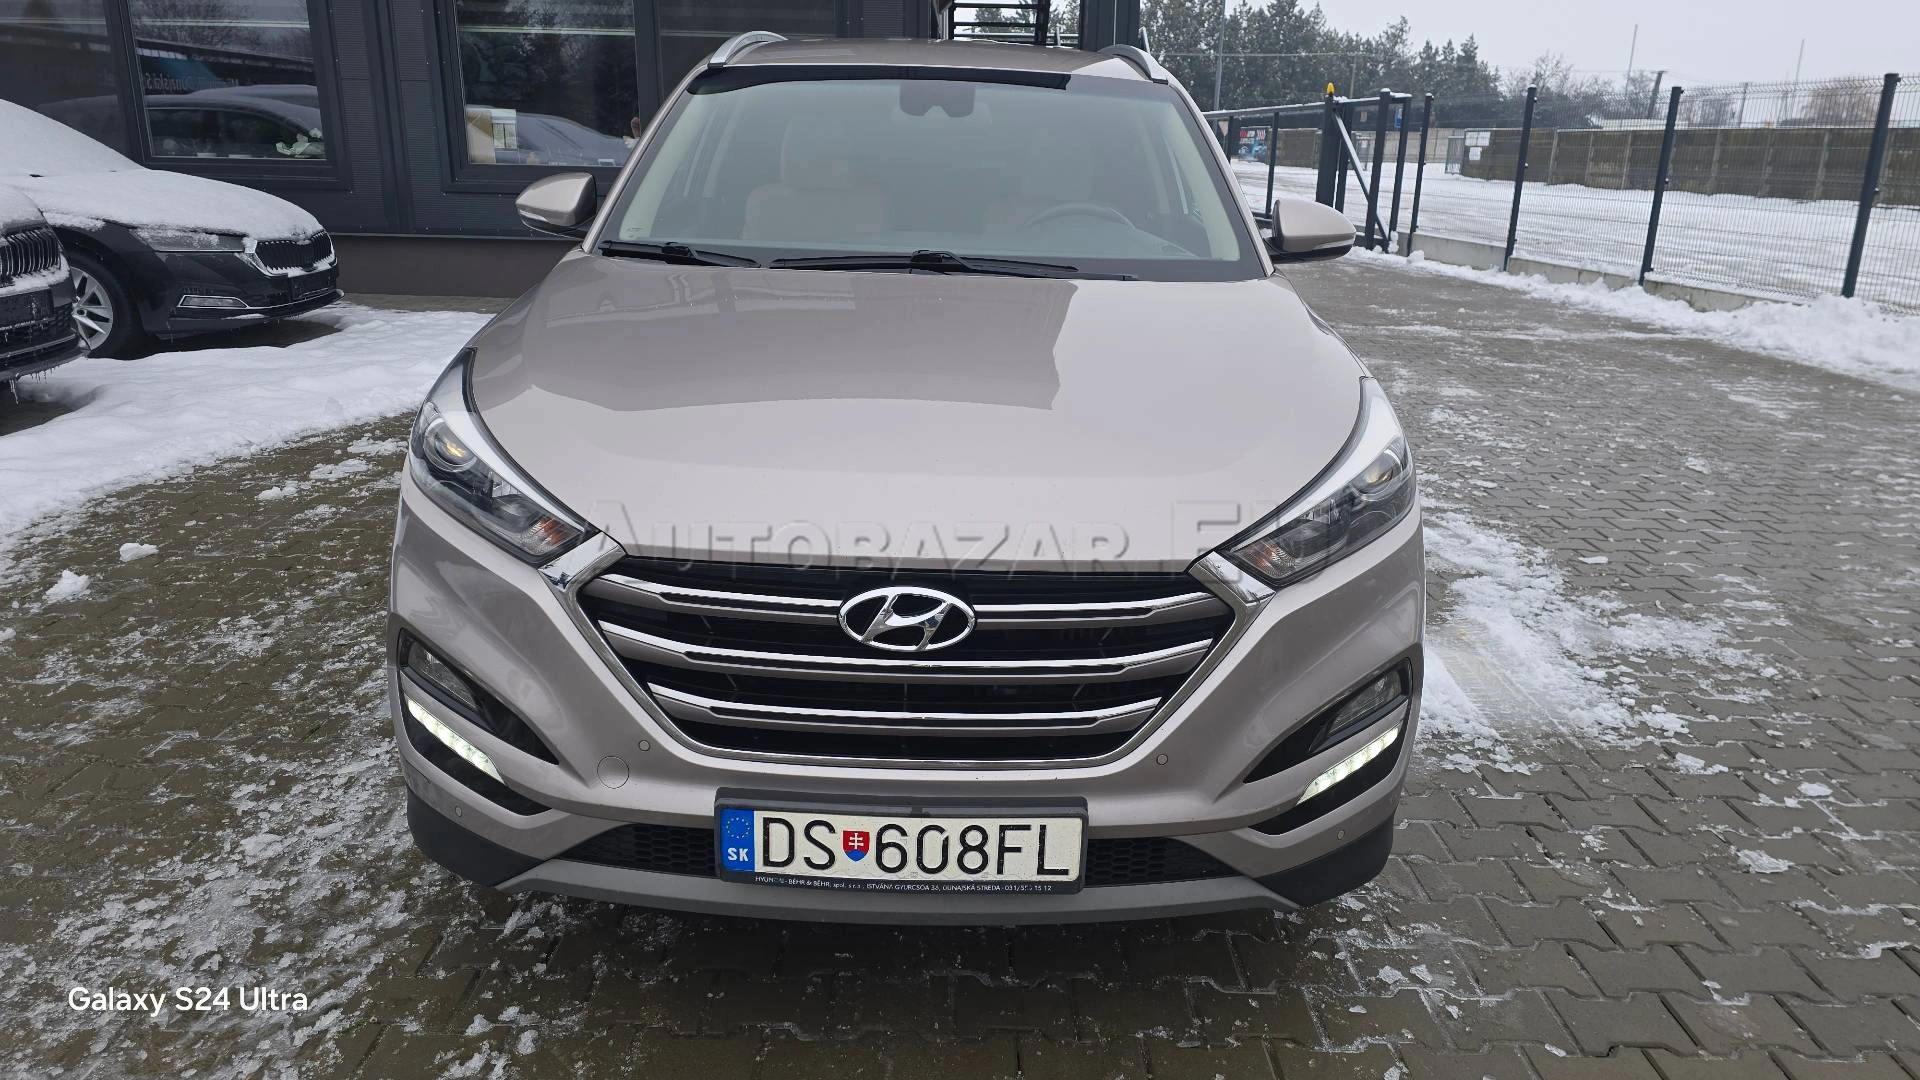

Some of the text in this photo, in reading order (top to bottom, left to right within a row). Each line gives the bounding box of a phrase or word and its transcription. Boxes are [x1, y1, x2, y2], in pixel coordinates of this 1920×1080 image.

[727, 847, 749, 862] SK
[762, 817, 1070, 876] DS 608FL
